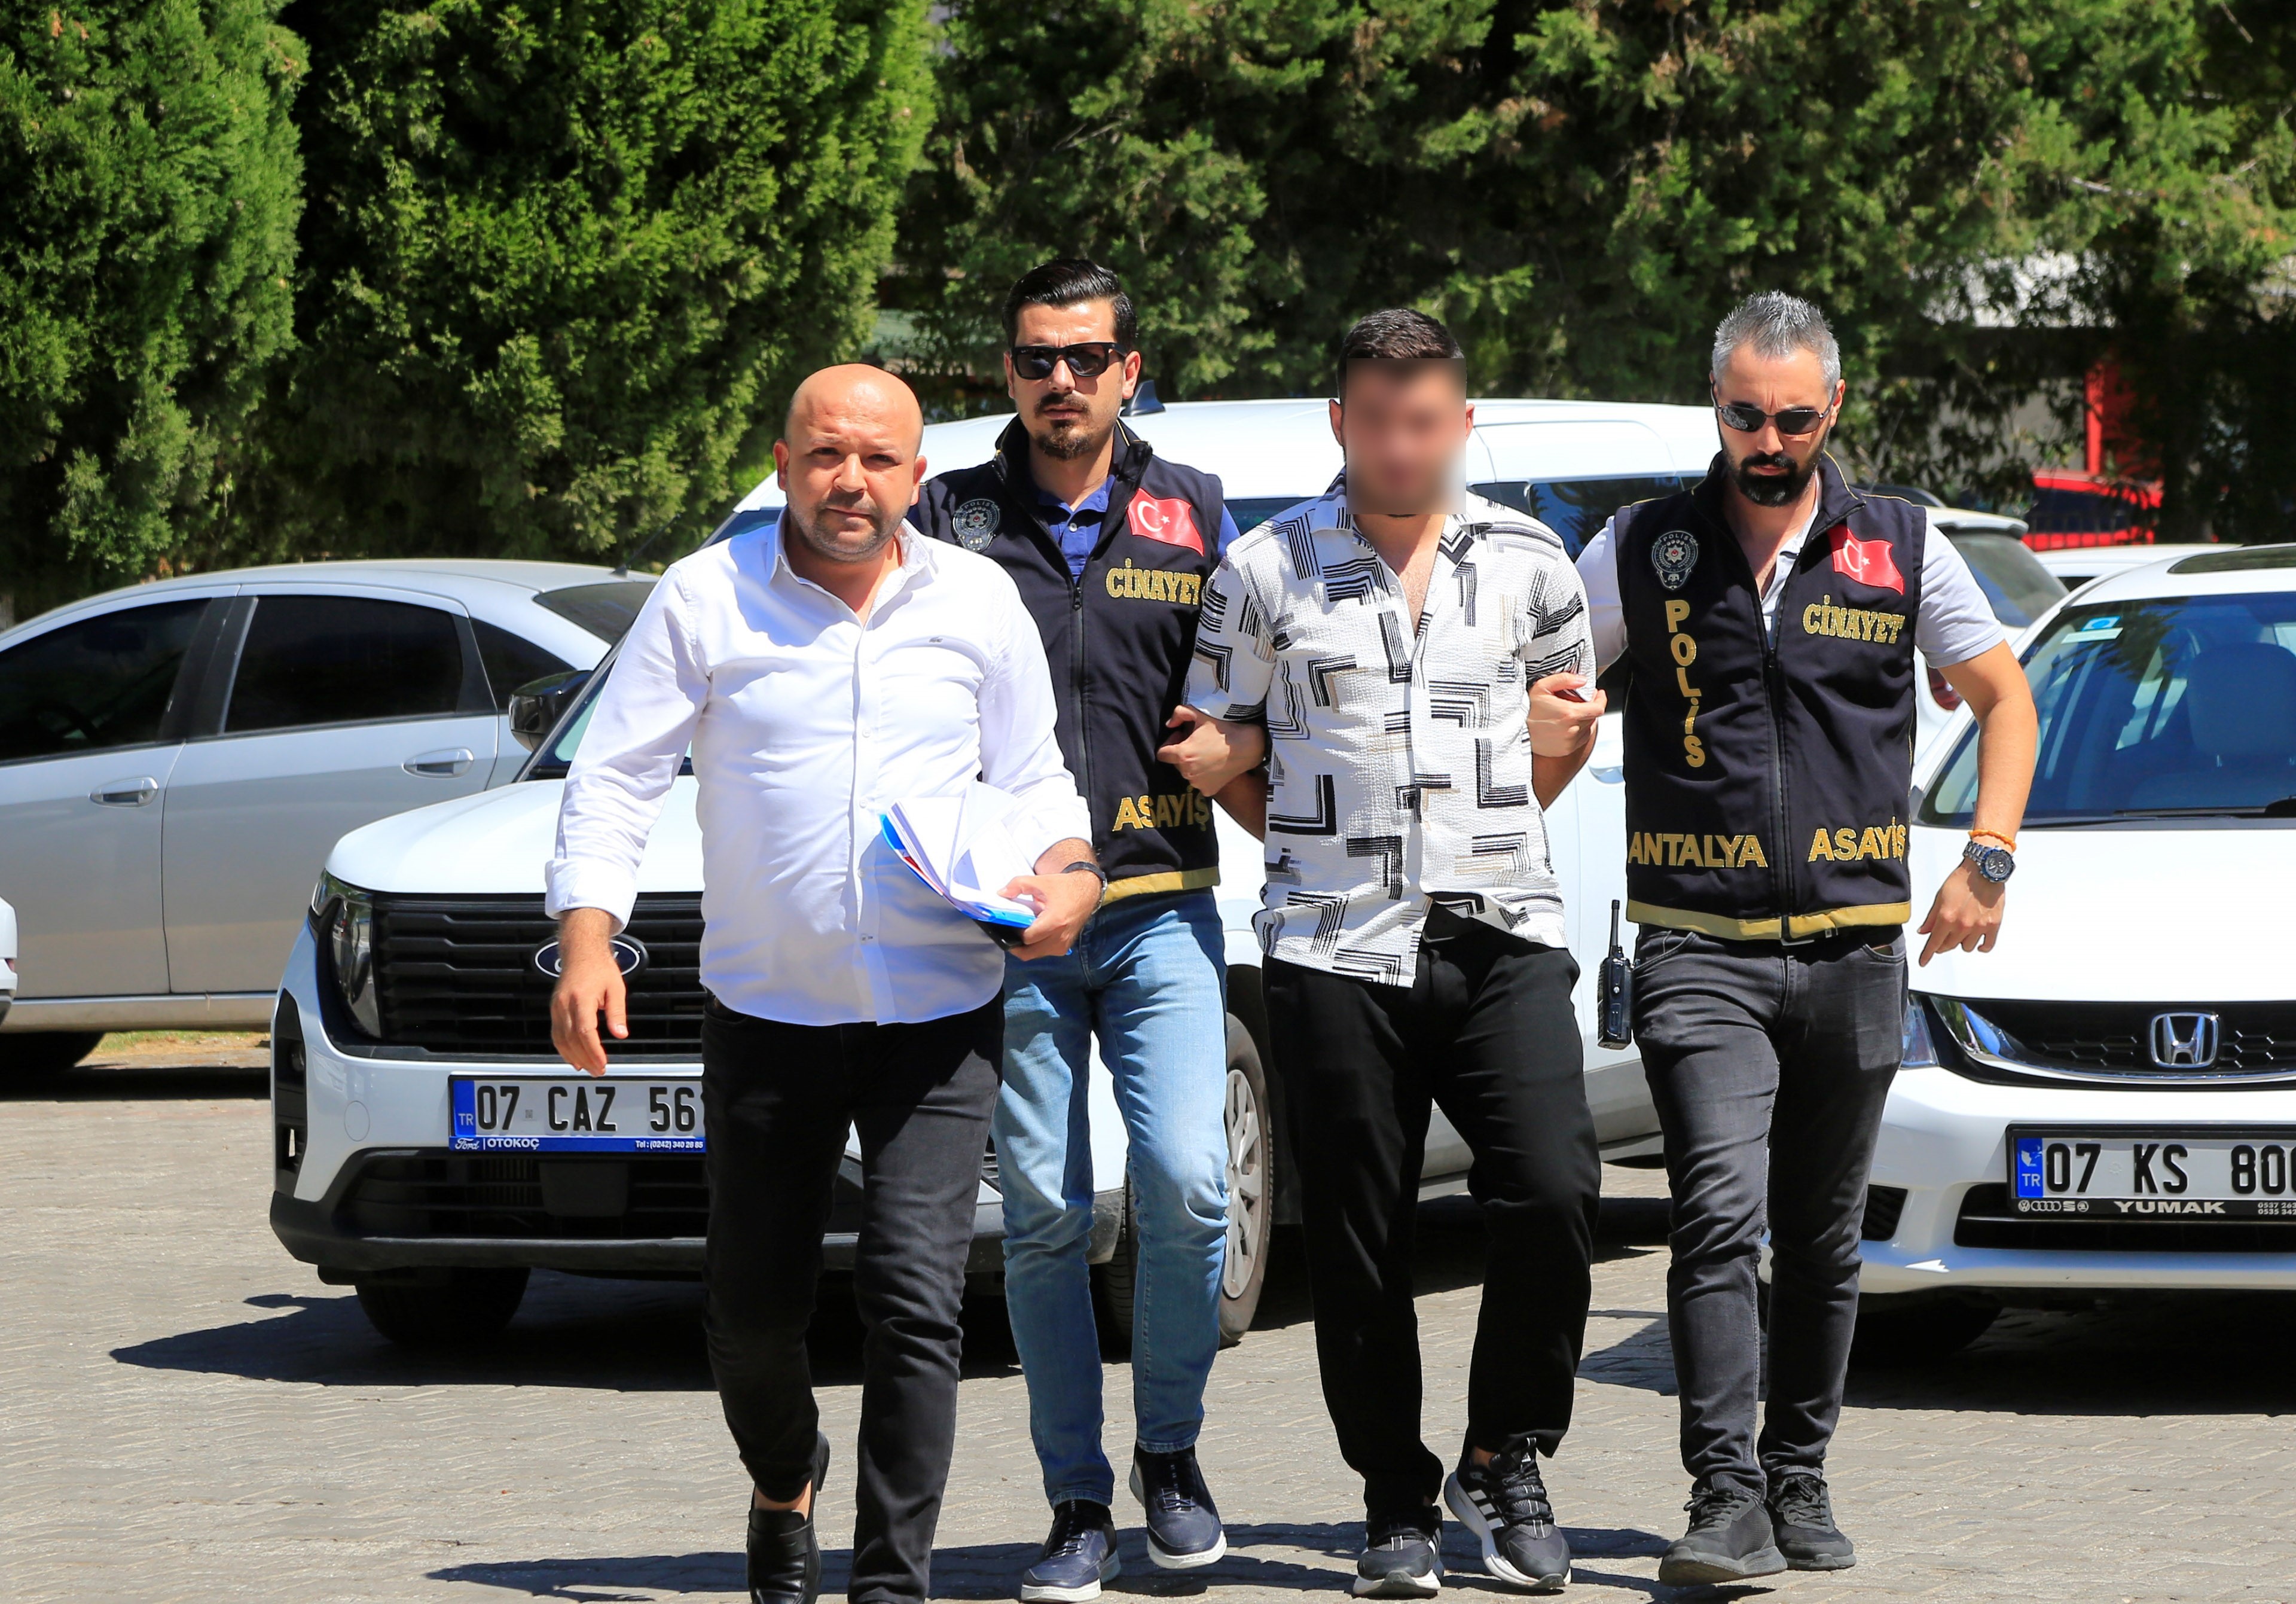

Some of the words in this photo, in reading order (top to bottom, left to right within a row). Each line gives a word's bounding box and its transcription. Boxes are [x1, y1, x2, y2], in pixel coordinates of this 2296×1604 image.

[1106, 557, 1201, 605] CİNAYET
[1802, 594, 1906, 644] CİNAYET
[1665, 599, 1705, 768] POLİS
[1112, 785, 1210, 832] ASAYİŞ
[1628, 831, 1768, 868] ANTALYA
[1808, 815, 1907, 864] ASAYİŞ
[458, 1113, 474, 1126] TR
[478, 1085, 520, 1132] 07
[548, 1086, 617, 1132] CAZ
[649, 1086, 695, 1132] 56
[455, 1138, 480, 1150] Ford
[487, 1138, 540, 1150] OTOKOÇ
[649, 1140, 672, 1149] (0242)
[2022, 1173, 2041, 1187] TR
[2045, 1143, 2102, 1193] 07
[2133, 1143, 2188, 1194] KS
[2231, 1143, 2296, 1194] 80
[2113, 1201, 2226, 1214] YUMAK
